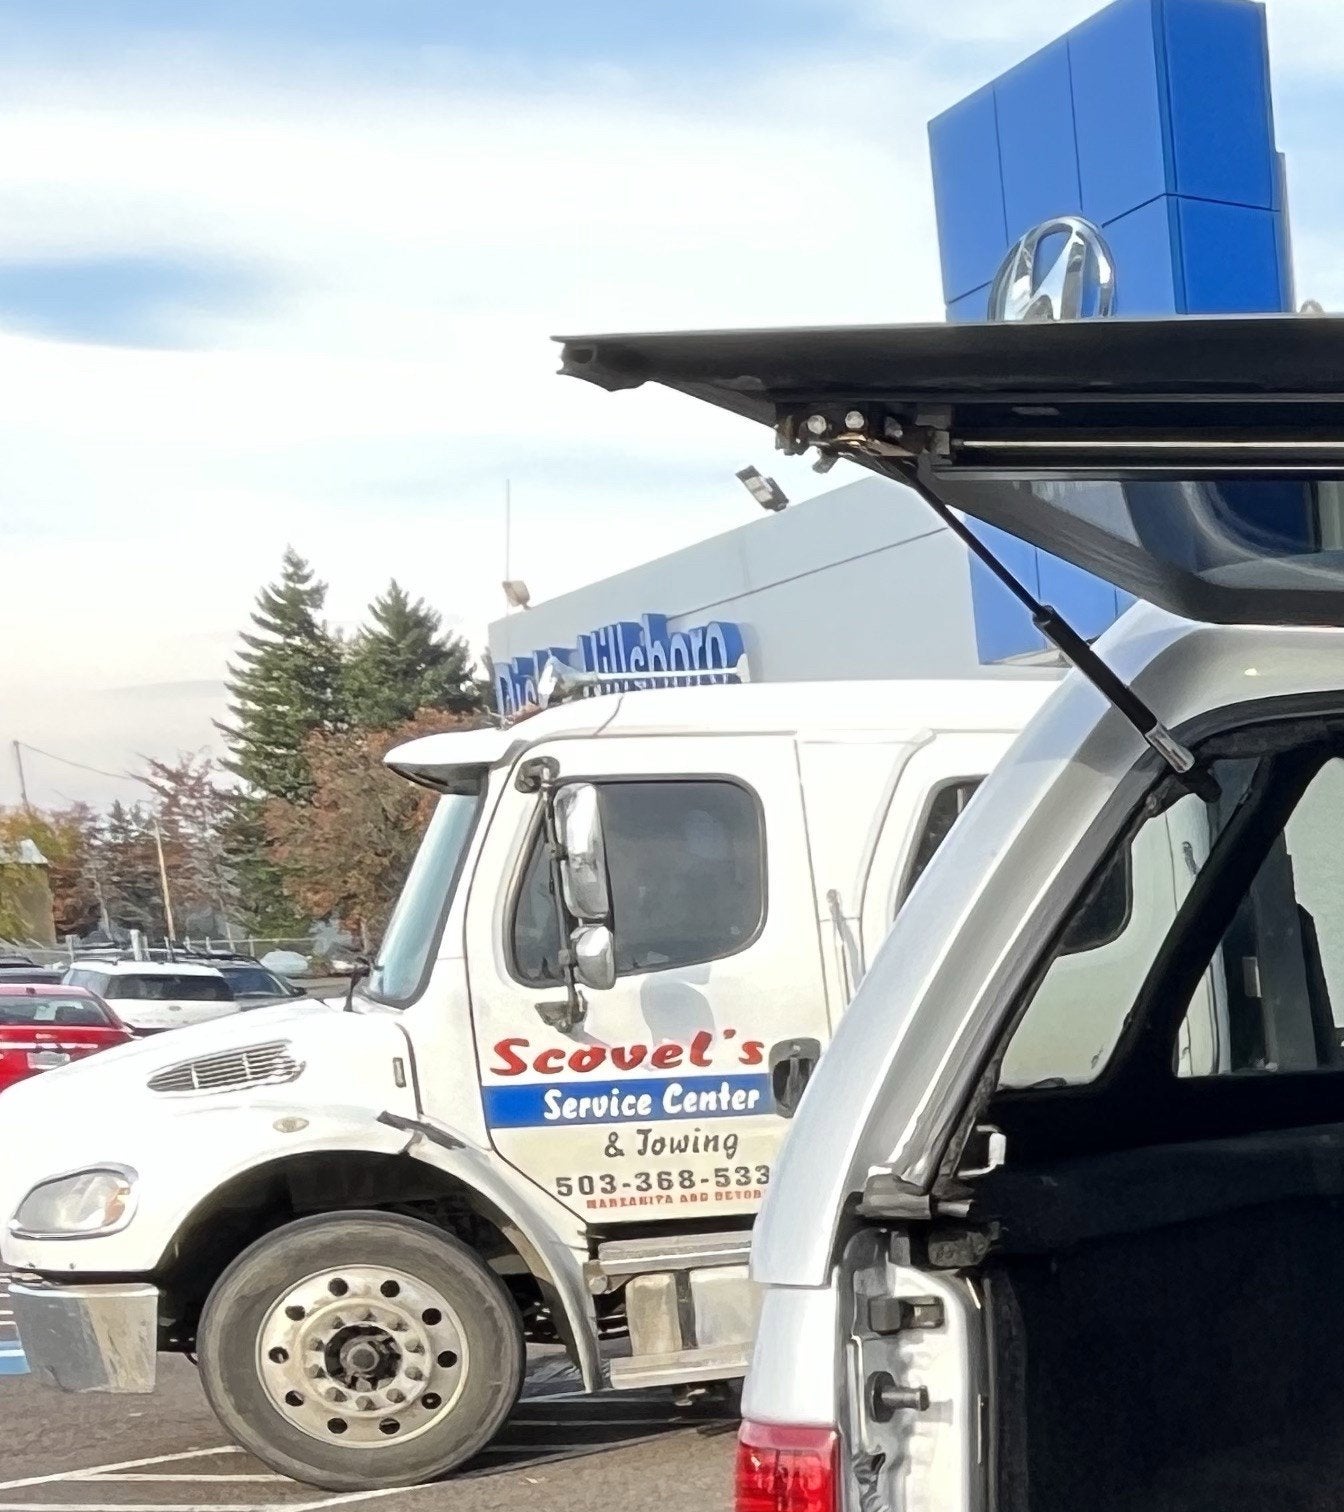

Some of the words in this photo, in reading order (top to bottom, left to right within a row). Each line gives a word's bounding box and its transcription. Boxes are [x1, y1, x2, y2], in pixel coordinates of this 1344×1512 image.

[490, 1029, 764, 1075] Scovel's
[543, 1088, 651, 1121] Service
[662, 1082, 760, 1114] Center
[604, 1132, 625, 1157] &
[636, 1128, 739, 1160] Towing
[555, 1164, 770, 1197] 503-368-533
